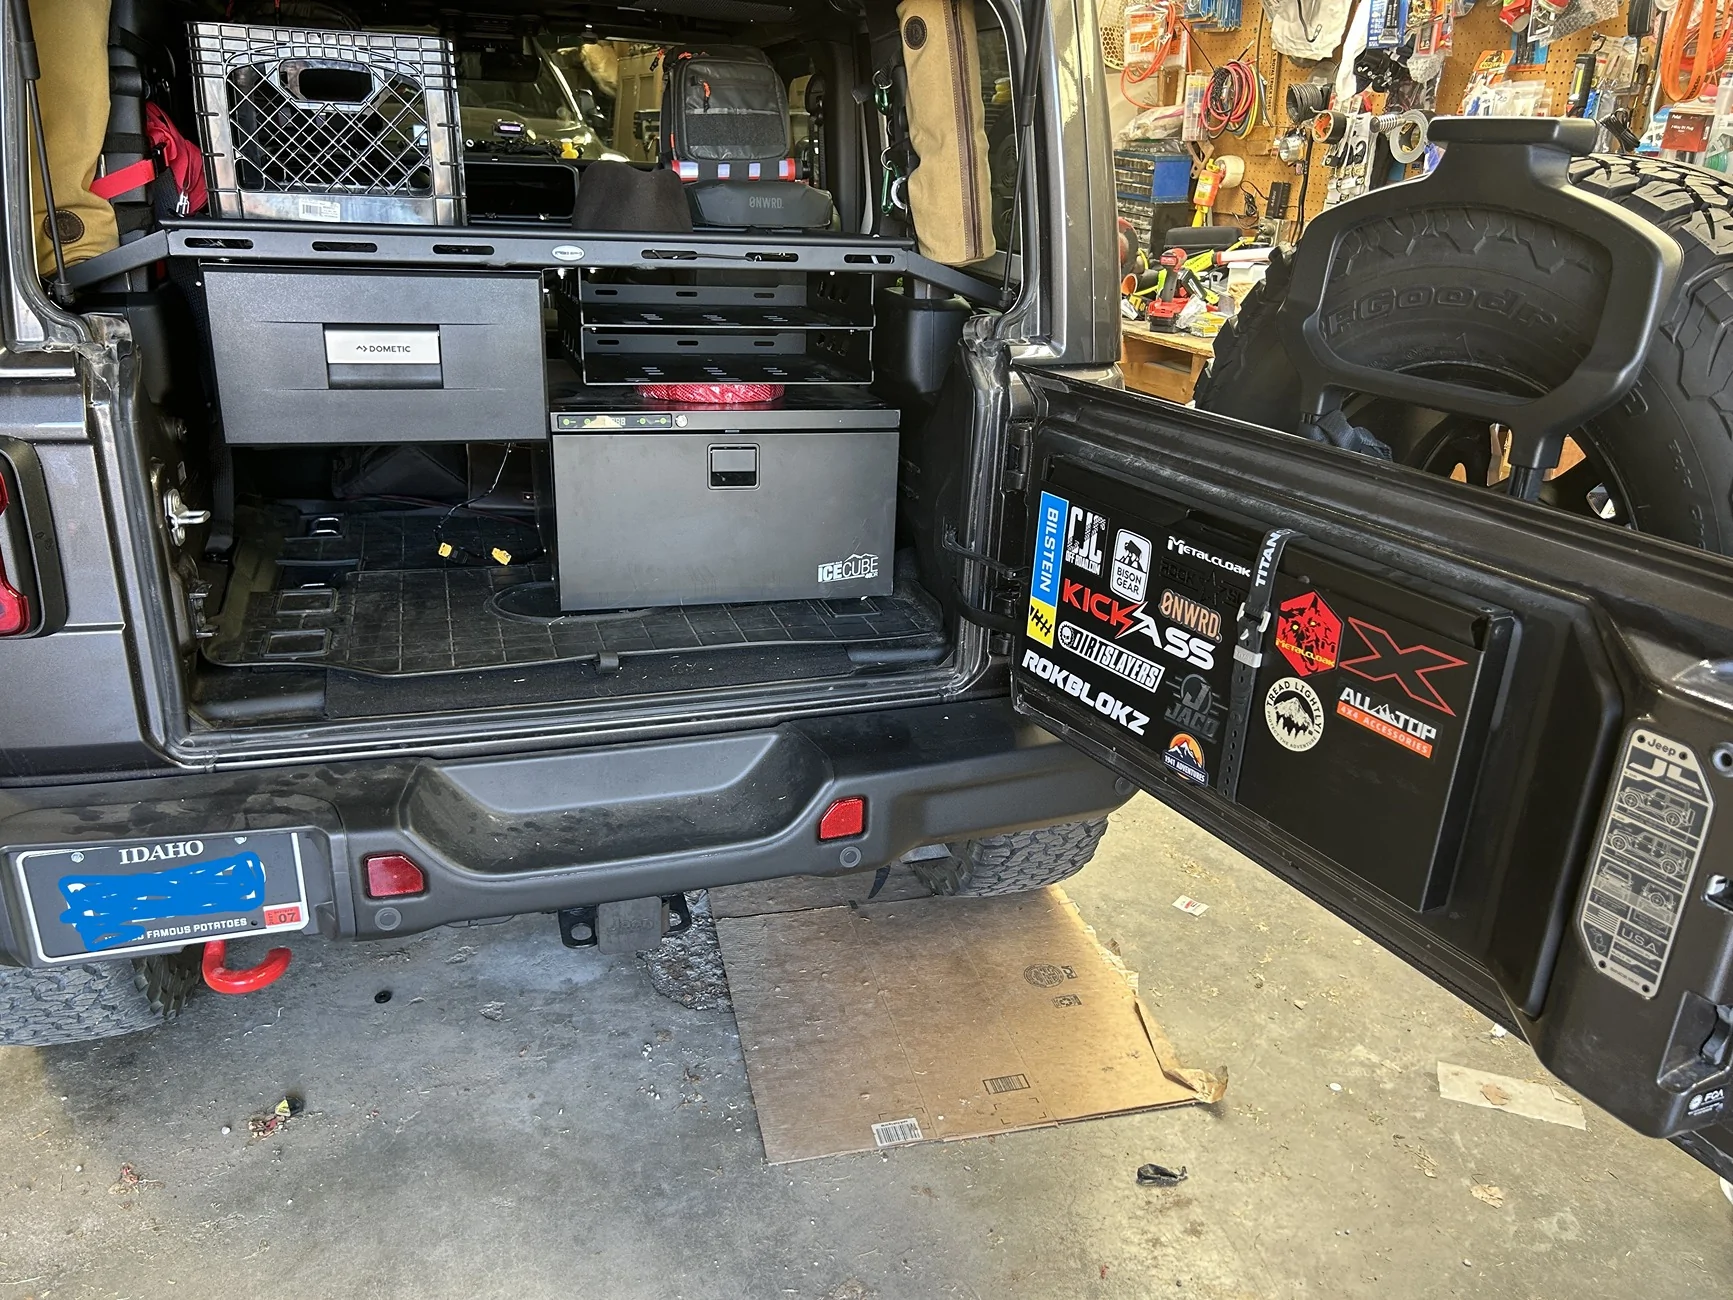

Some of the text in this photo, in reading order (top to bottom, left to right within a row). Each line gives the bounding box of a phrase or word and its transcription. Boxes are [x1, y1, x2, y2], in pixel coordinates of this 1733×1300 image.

[369, 345, 411, 353] DOMETIC
[1040, 507, 1060, 593] BILSTEIN
[1065, 550, 1076, 563] OFF
[1116, 567, 1142, 586] BISON
[1116, 577, 1140, 595] GEAR
[1022, 648, 1150, 736] ROKBLOKZ
[1266, 681, 1290, 707] TREAD
[1164, 702, 1221, 738] JACO
[1266, 710, 1280, 737] PROTECT
[1290, 737, 1318, 750] ADVENTURE
[1363, 716, 1429, 754] ACCESSORIES
[1647, 738, 1676, 756] Jeep
[1176, 761, 1206, 783] ADVENTURES
[118, 839, 204, 865] IDAHO
[146, 925, 191, 939] FAMOUS
[193, 917, 248, 933] POTATOES
[278, 912, 297, 924] 07
